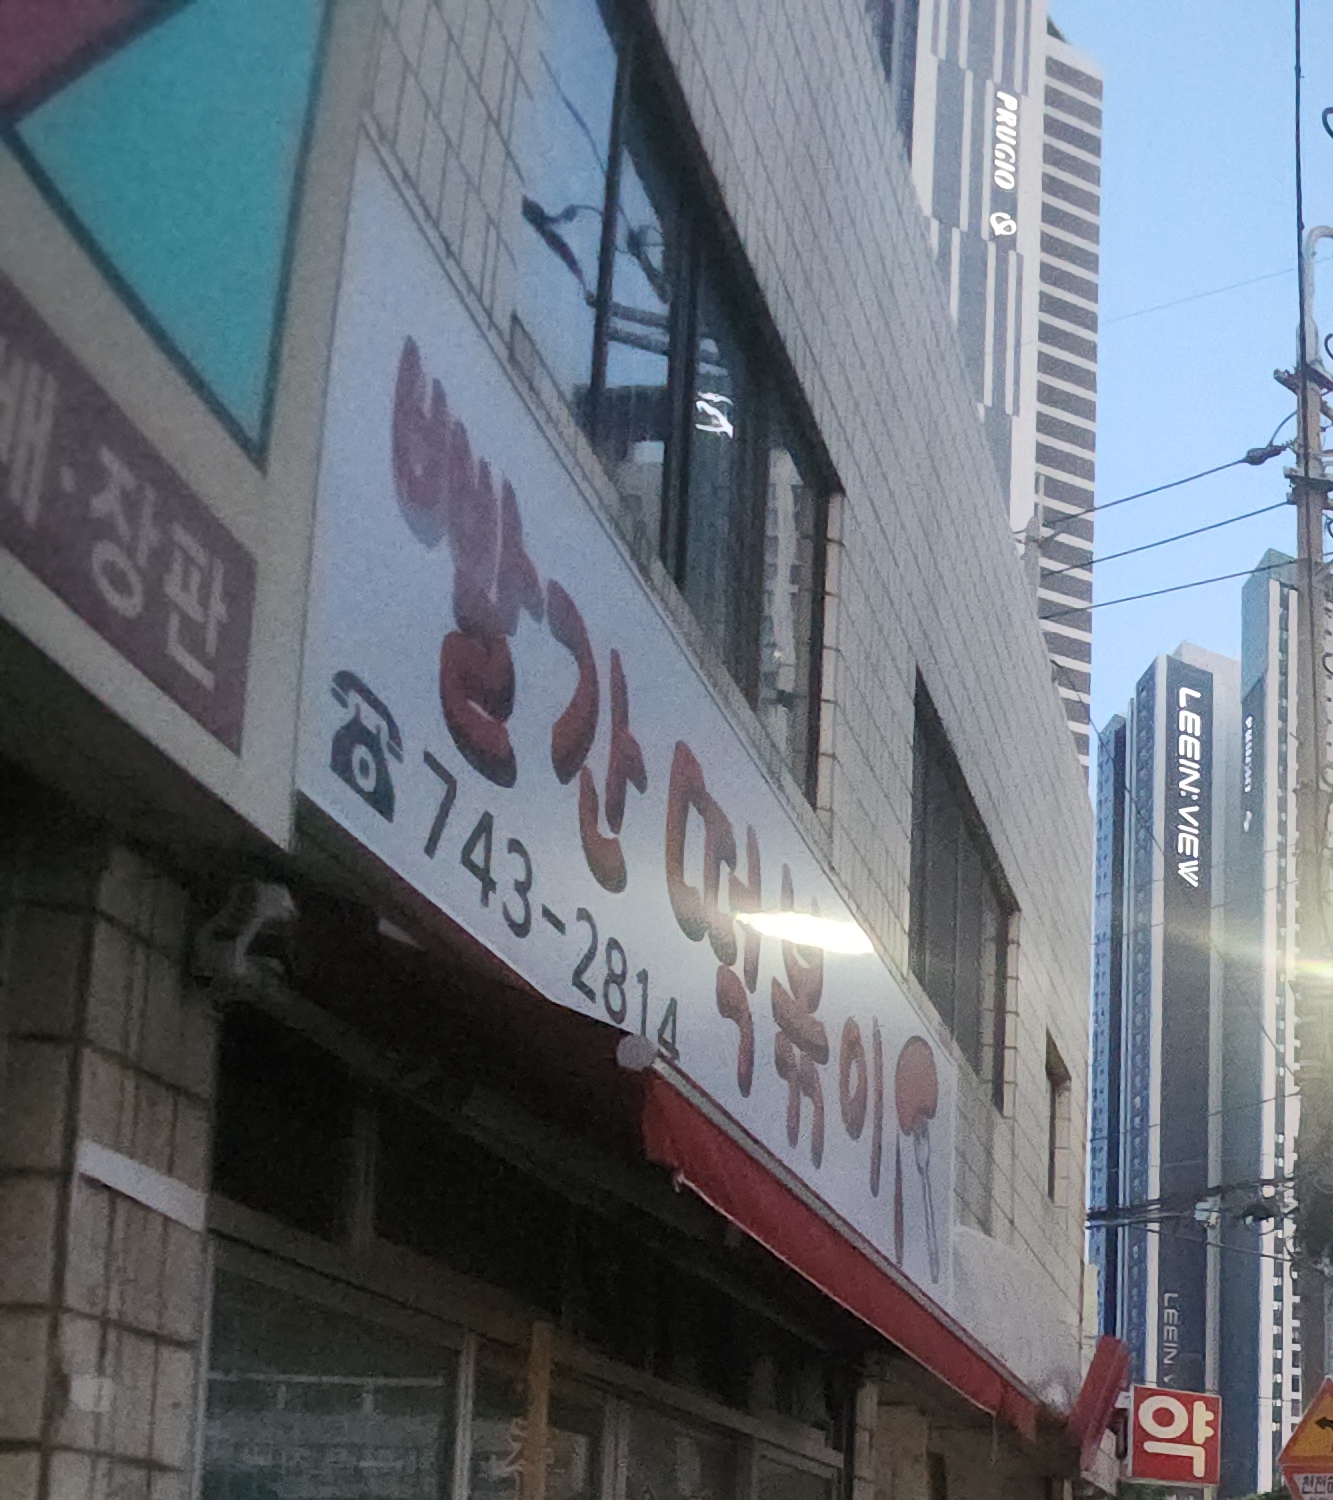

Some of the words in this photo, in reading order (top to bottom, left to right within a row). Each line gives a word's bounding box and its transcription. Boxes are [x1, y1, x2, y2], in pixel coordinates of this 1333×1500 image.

[993, 90, 1018, 190] PRUGIO
[390, 334, 648, 894] 빨간
[1177, 805, 1200, 887] VIEW
[422, 748, 681, 1063] 743-2814
[1162, 1292, 1180, 1365] LEEIN
[1137, 1394, 1216, 1478] 약
